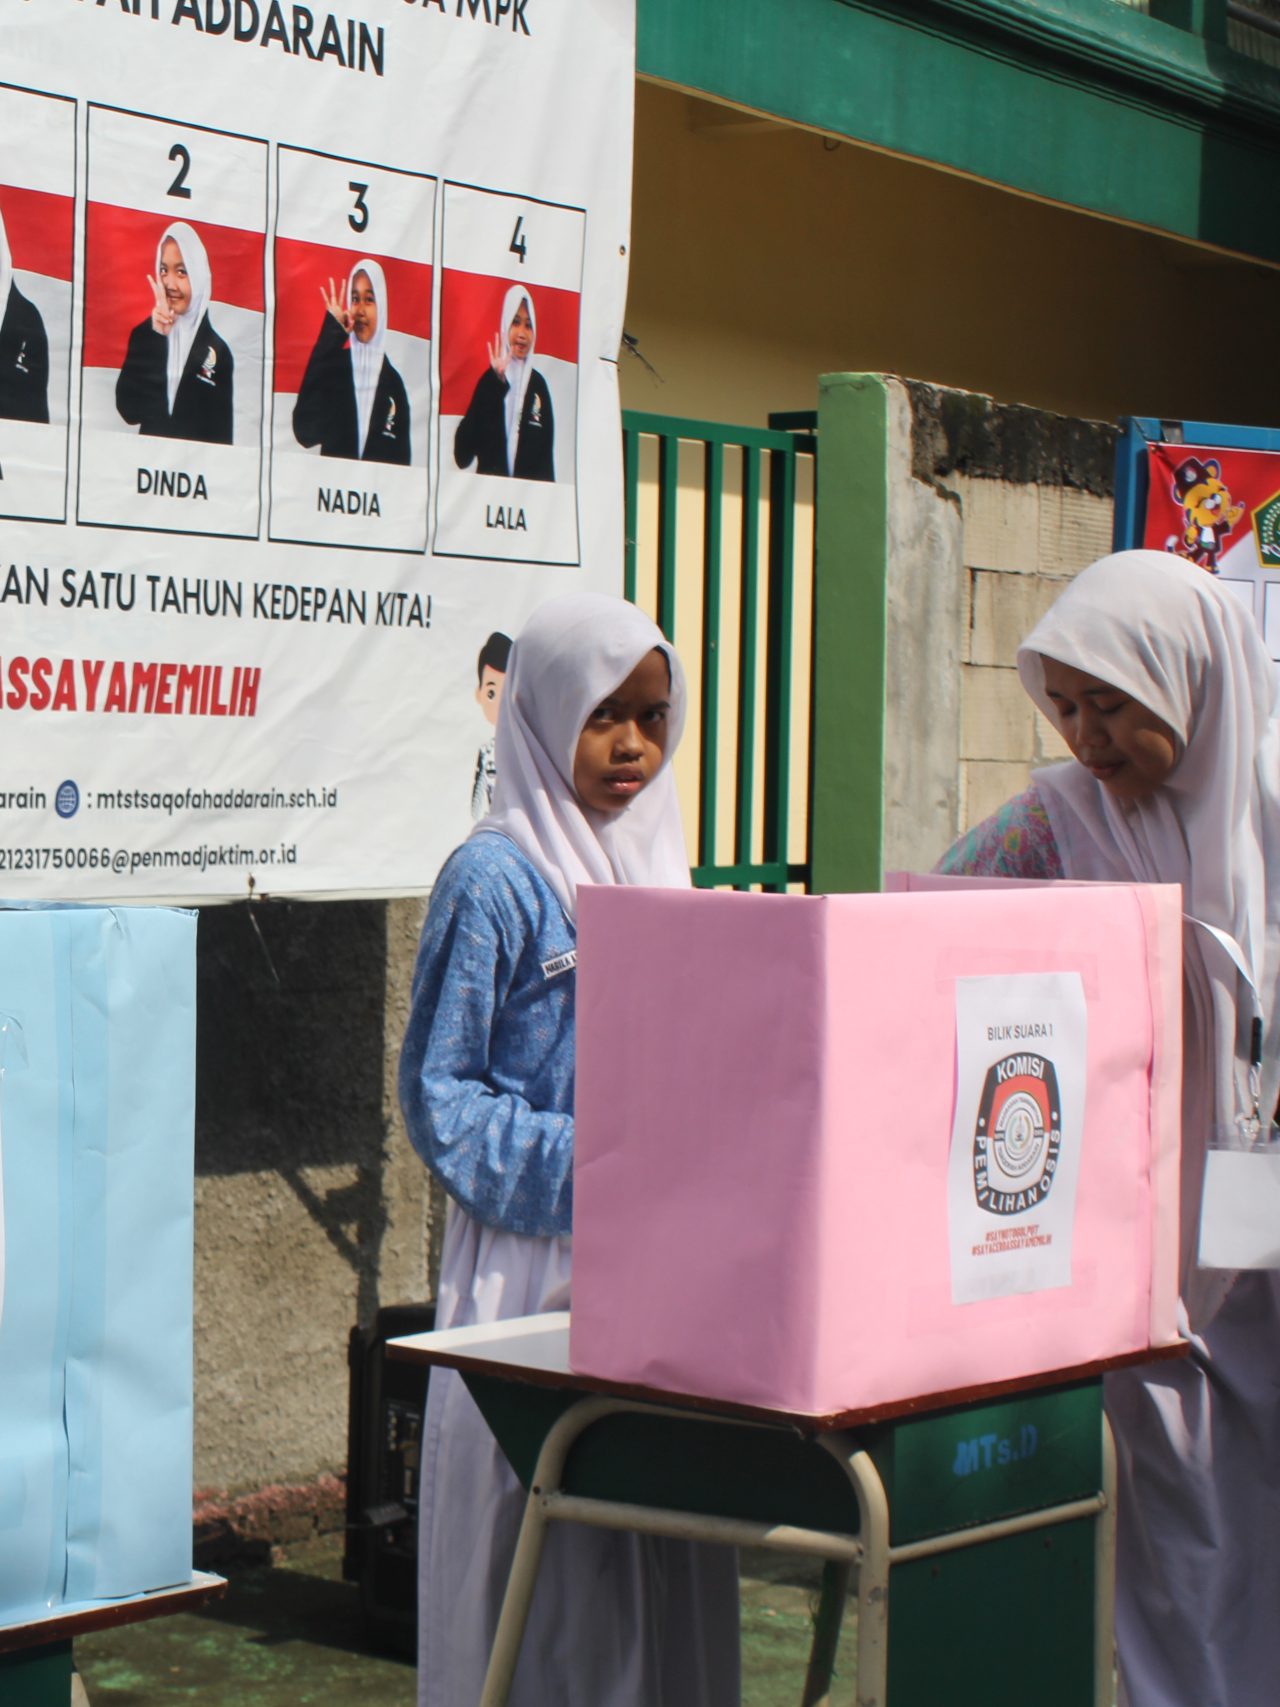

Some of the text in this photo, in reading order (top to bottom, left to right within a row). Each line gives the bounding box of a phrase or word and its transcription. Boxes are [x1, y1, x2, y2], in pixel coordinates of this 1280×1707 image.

[167, 144, 191, 199] 2
[348, 182, 368, 233] 3
[509, 216, 526, 263] 4
[138, 468, 207, 500] DINDA
[318, 488, 380, 516] NADIA
[487, 505, 526, 530] LALA
[60, 569, 135, 611] SATU
[147, 575, 241, 617] TAHUN
[254, 583, 366, 624] KEDEPAN
[376, 592, 431, 628] KITA!
[97, 788, 336, 815] mtstsaqofahaddarain.sch.id
[987, 1025, 1012, 1041] BILIK
[1014, 1023, 1047, 1040] SUARA
[996, 1055, 1044, 1083] KOMISI
[975, 1136, 1038, 1213] PEMILIHAN
[1040, 1129, 1061, 1190] OSIS
